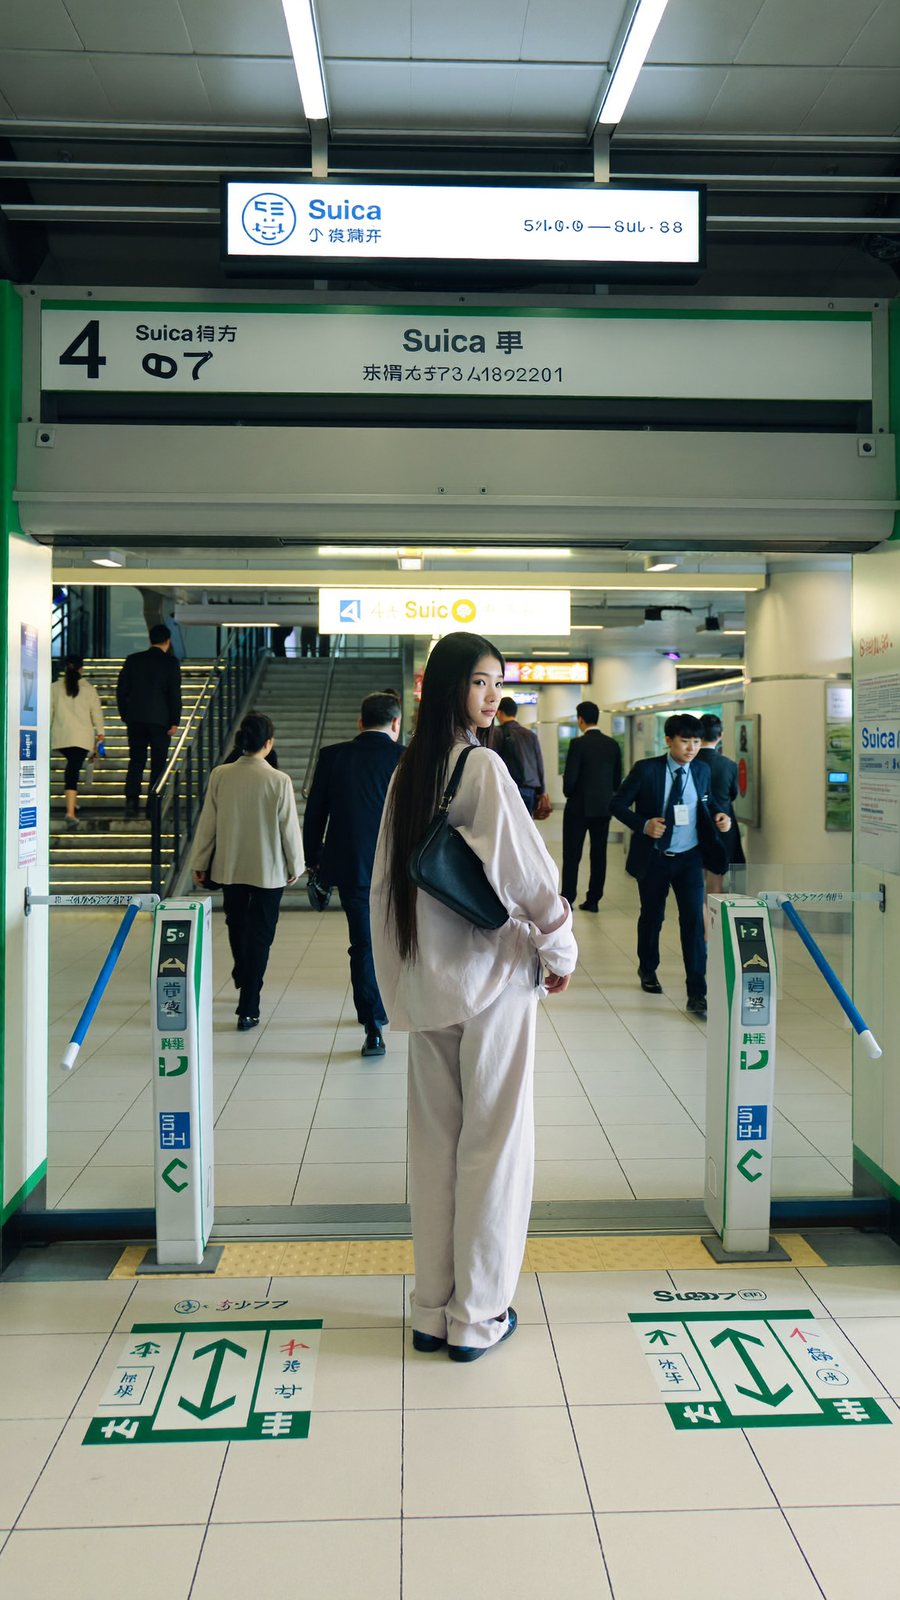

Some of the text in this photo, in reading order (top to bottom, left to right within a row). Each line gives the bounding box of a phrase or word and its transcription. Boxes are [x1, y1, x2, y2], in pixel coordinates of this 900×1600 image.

[308, 198, 382, 220] Suica
[135, 324, 193, 341] Suica
[402, 328, 486, 353] Suica
[59, 320, 107, 379] 4
